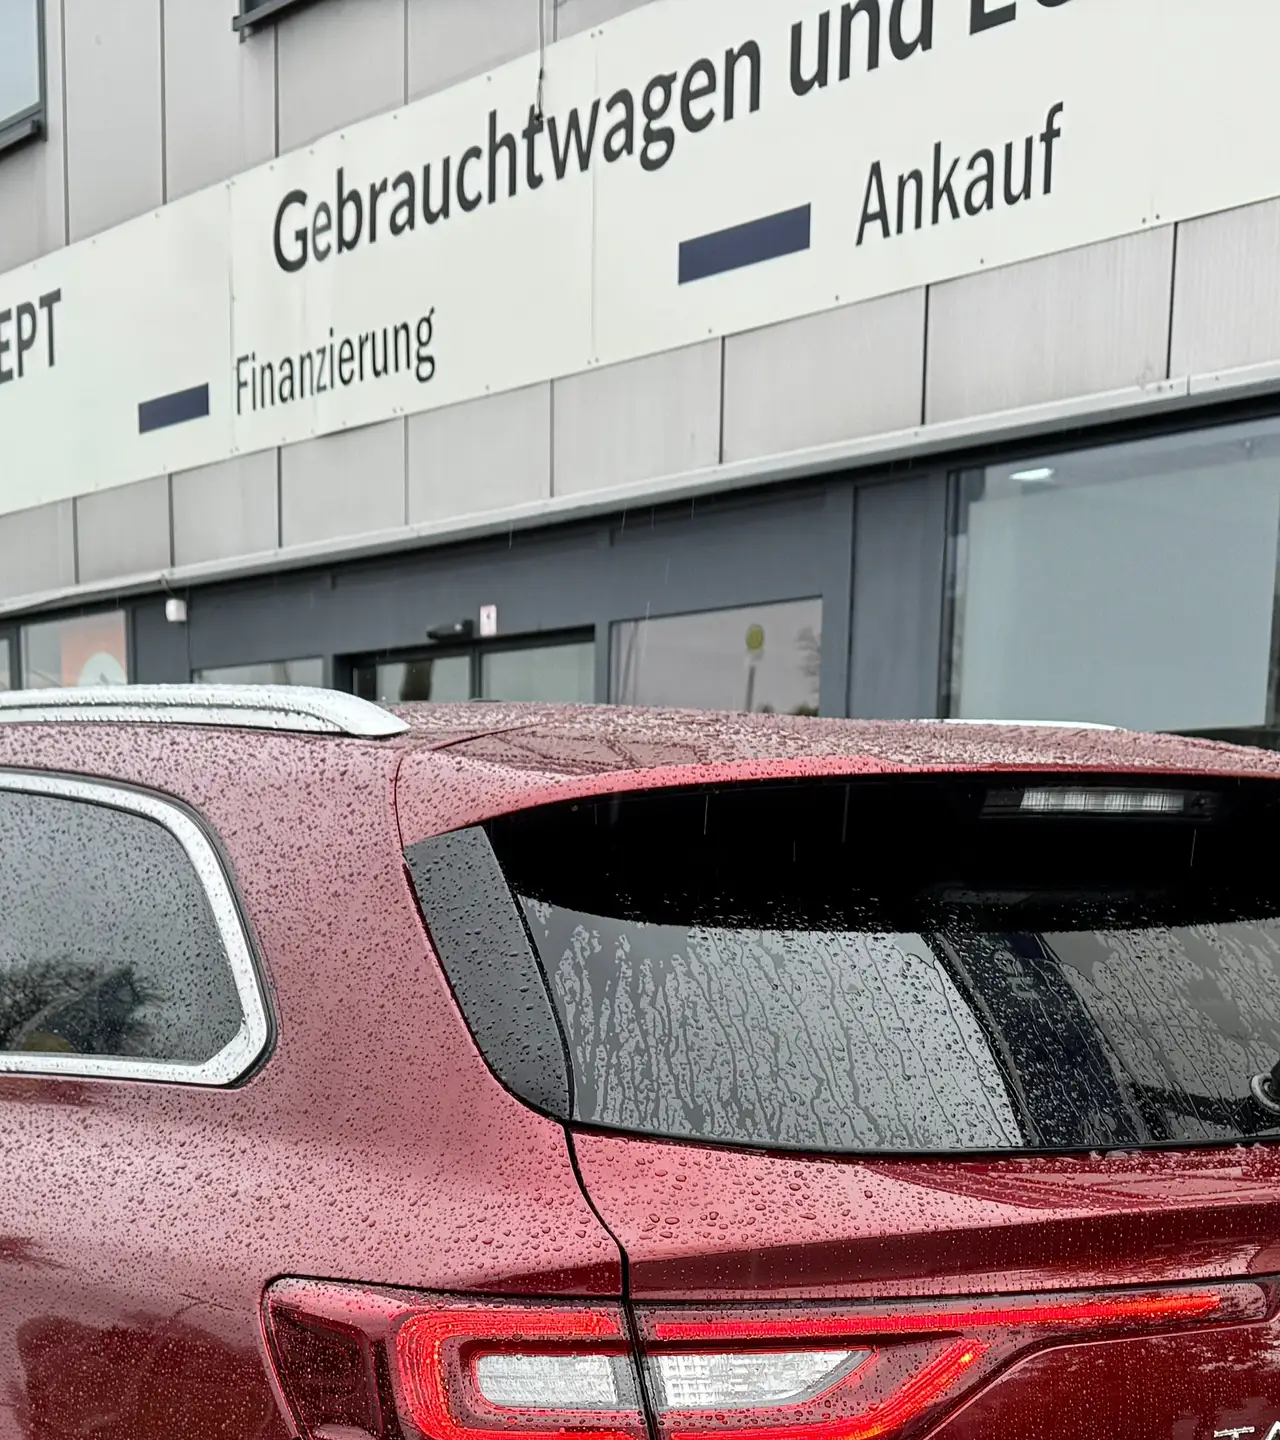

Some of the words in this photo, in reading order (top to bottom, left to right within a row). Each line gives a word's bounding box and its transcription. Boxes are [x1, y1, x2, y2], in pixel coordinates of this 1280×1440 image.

[272, 38, 761, 274] Gebrauchtwagen
[856, 100, 1064, 247] Ankauf
[235, 306, 436, 416] Finanzierung
